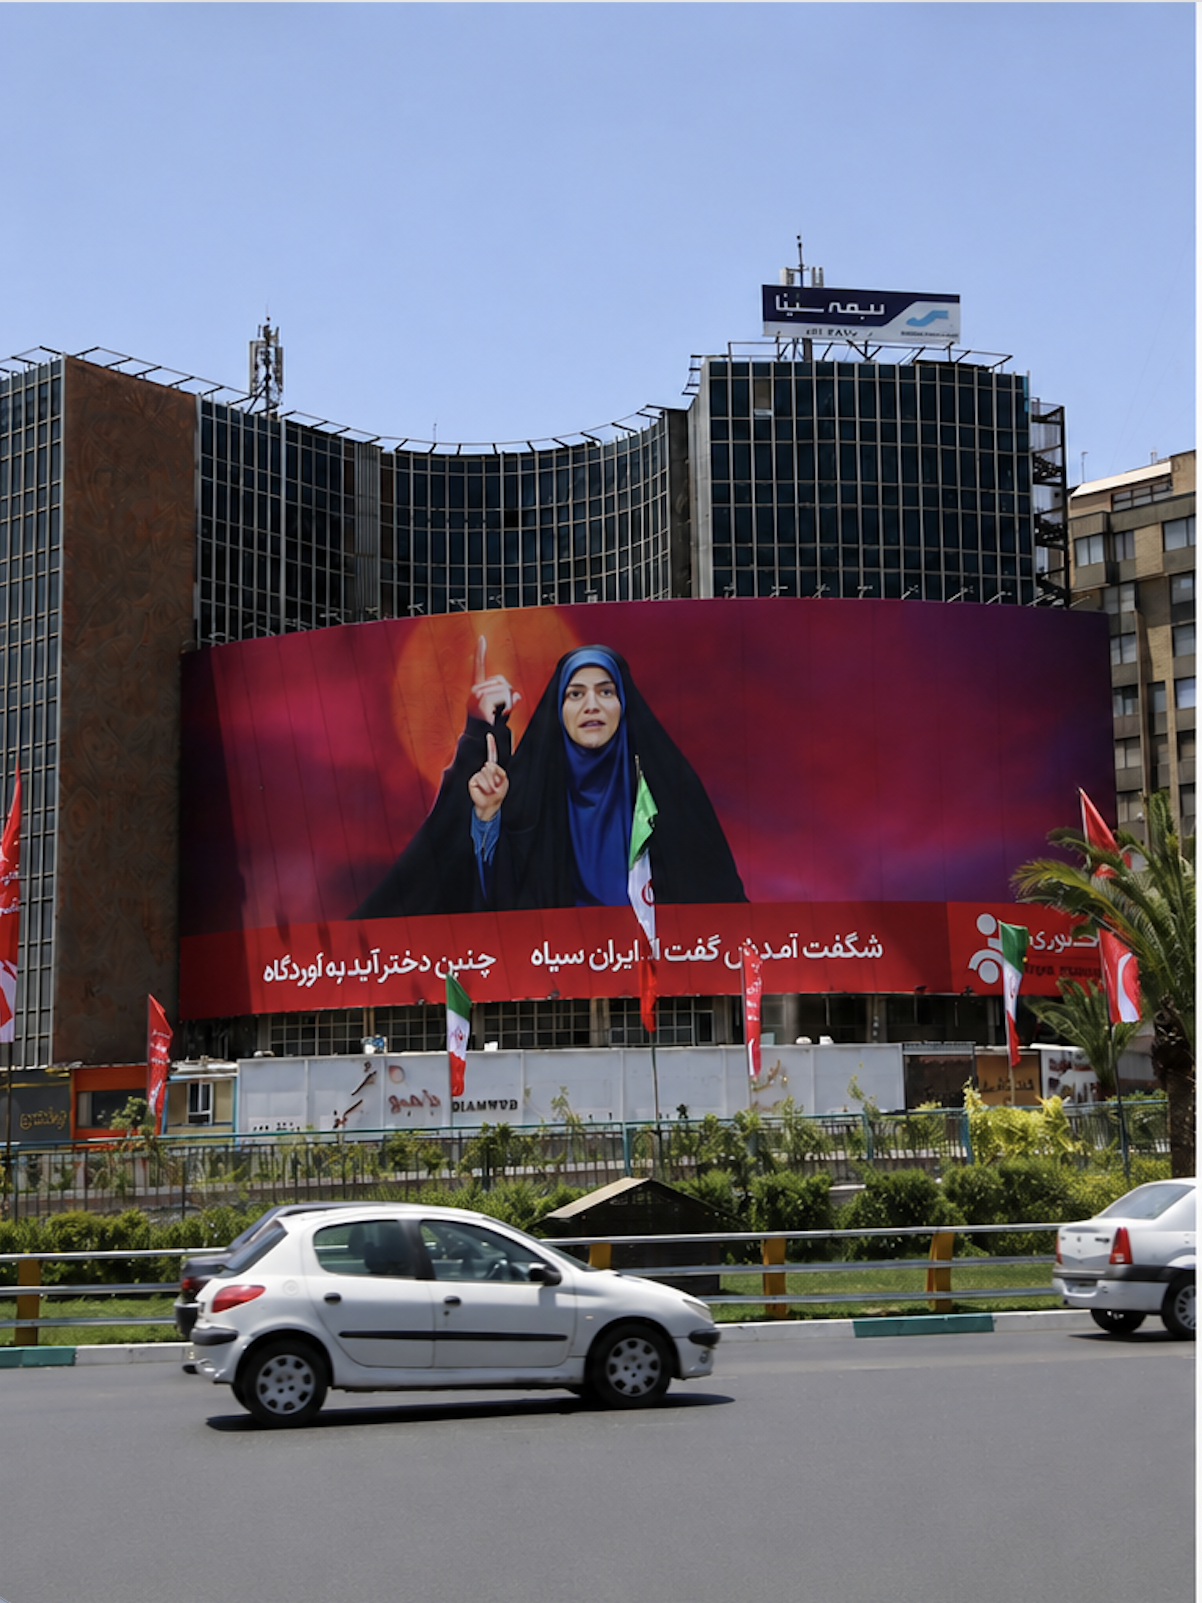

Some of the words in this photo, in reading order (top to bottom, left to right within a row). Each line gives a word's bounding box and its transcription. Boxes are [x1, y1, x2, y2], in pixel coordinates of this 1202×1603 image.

[589, 938, 640, 972] ایران
[664, 935, 721, 962] گفت
[802, 931, 883, 959] شگفت
[263, 951, 324, 988] آوردگاه
[325, 960, 345, 985] به
[347, 947, 381, 981] آید
[377, 950, 431, 983] دختر
